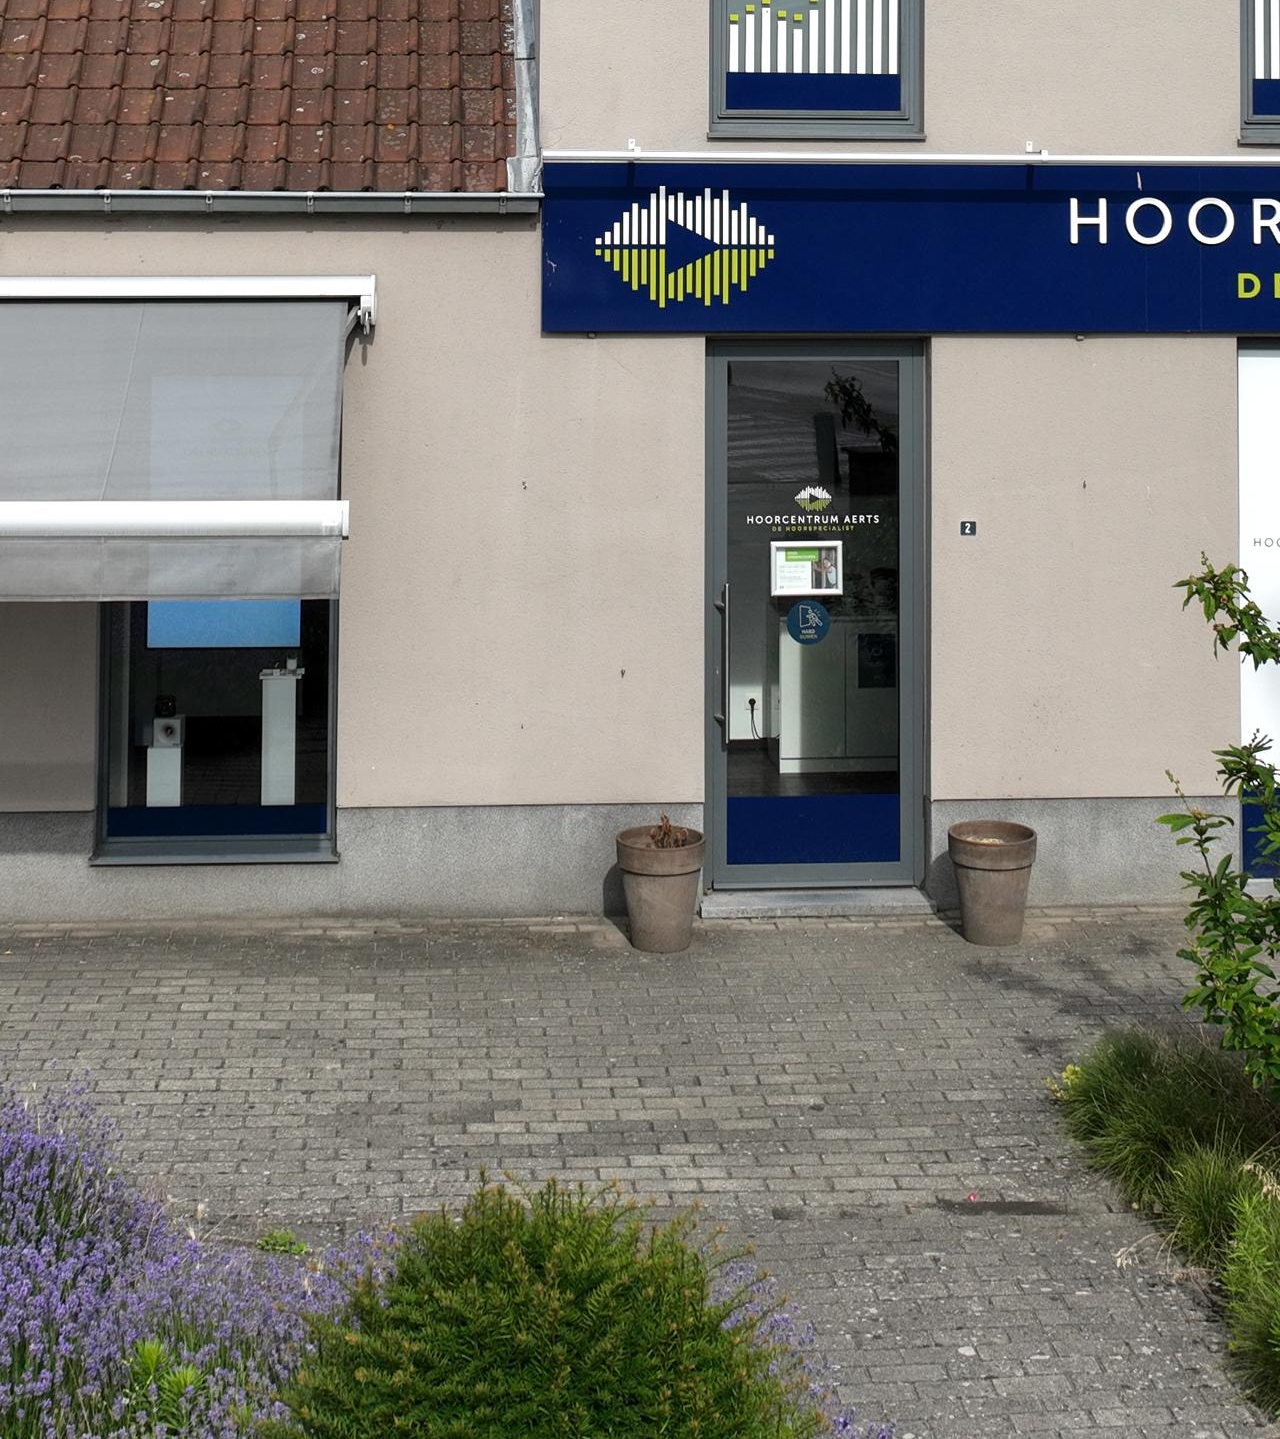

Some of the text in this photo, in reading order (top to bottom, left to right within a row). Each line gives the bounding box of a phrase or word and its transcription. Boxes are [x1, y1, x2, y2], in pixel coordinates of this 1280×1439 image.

[746, 514, 881, 525] HOORCENTRUM AERTS
[964, 522, 971, 534] 2
